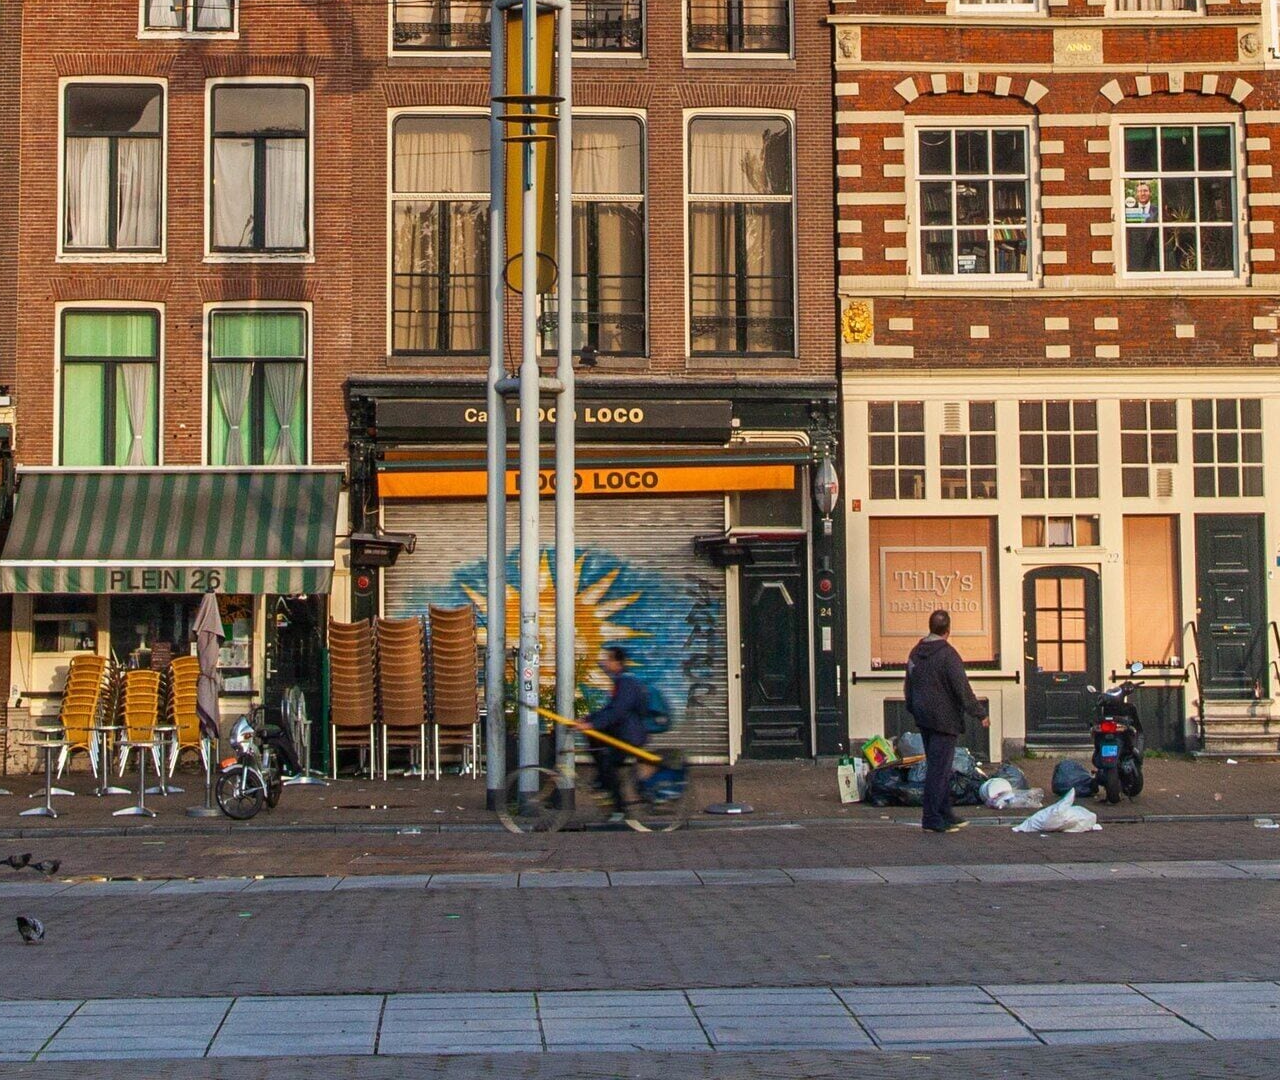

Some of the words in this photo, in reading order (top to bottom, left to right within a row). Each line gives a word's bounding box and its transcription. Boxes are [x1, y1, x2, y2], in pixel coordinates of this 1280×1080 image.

[584, 407, 644, 423] LOCO
[593, 471, 659, 490] LOCO
[110, 570, 180, 590] PLEIN
[191, 570, 221, 589] 26
[894, 570, 974, 597] Tilly's
[820, 607, 832, 617] 24
[889, 598, 980, 614] nailstudio
